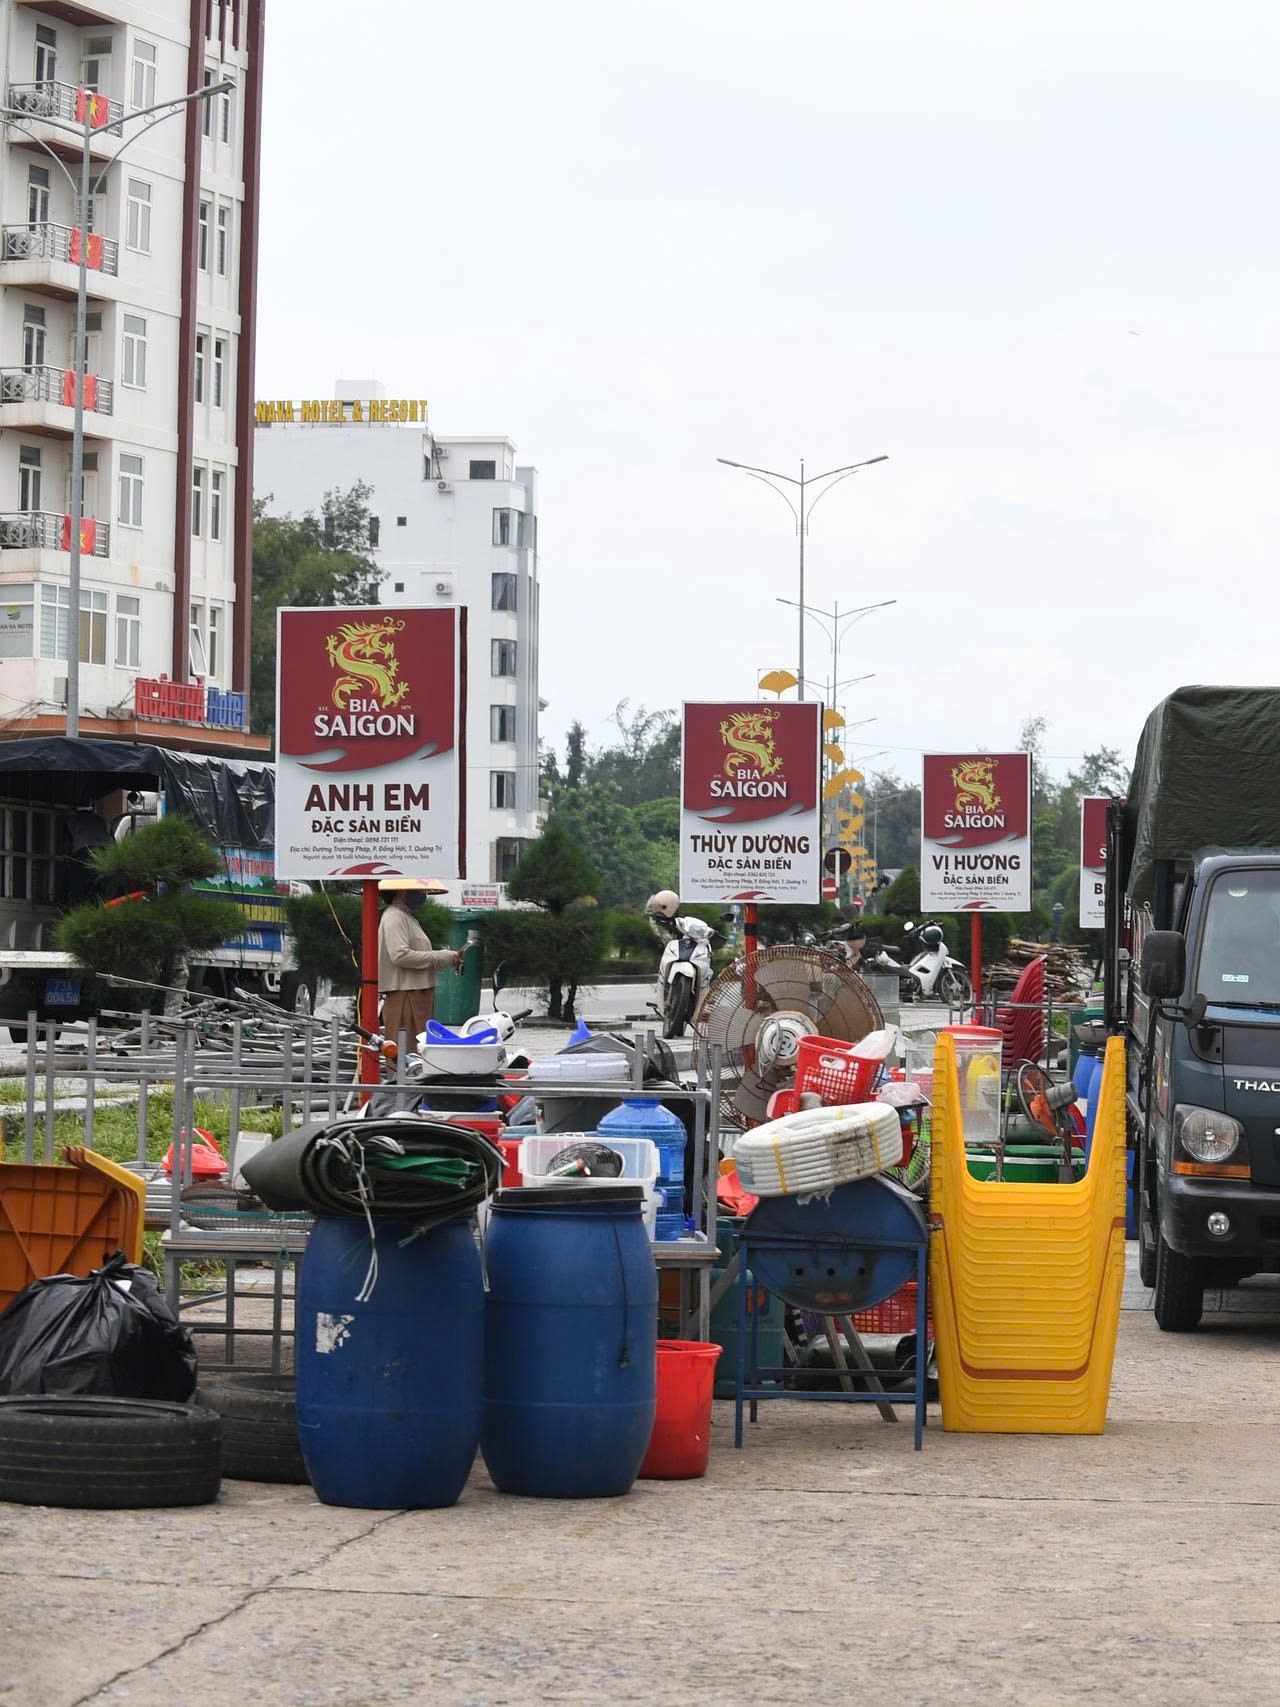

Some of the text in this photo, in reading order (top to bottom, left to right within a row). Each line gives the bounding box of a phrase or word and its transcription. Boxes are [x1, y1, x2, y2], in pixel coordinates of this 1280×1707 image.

[256, 400, 427, 422] NAVA HOTEL & RESORT
[350, 699, 380, 712] BIA
[314, 714, 415, 736] SAIGON
[738, 769, 760, 780] BIA
[305, 783, 429, 811] ANH EM
[710, 780, 787, 798] SAIGON
[965, 805, 984, 814] BIA
[312, 814, 421, 837] ĐẶC SẢN BIỂN
[944, 815, 1005, 828] SAIGON
[690, 830, 810, 854] THÙY DƯƠNG
[708, 855, 791, 872] ĐẶC SẢN BIỂN
[932, 854, 1020, 875] VỊ HƯƠNG
[944, 873, 1009, 886] ĐẶC SẢN BIỂN
